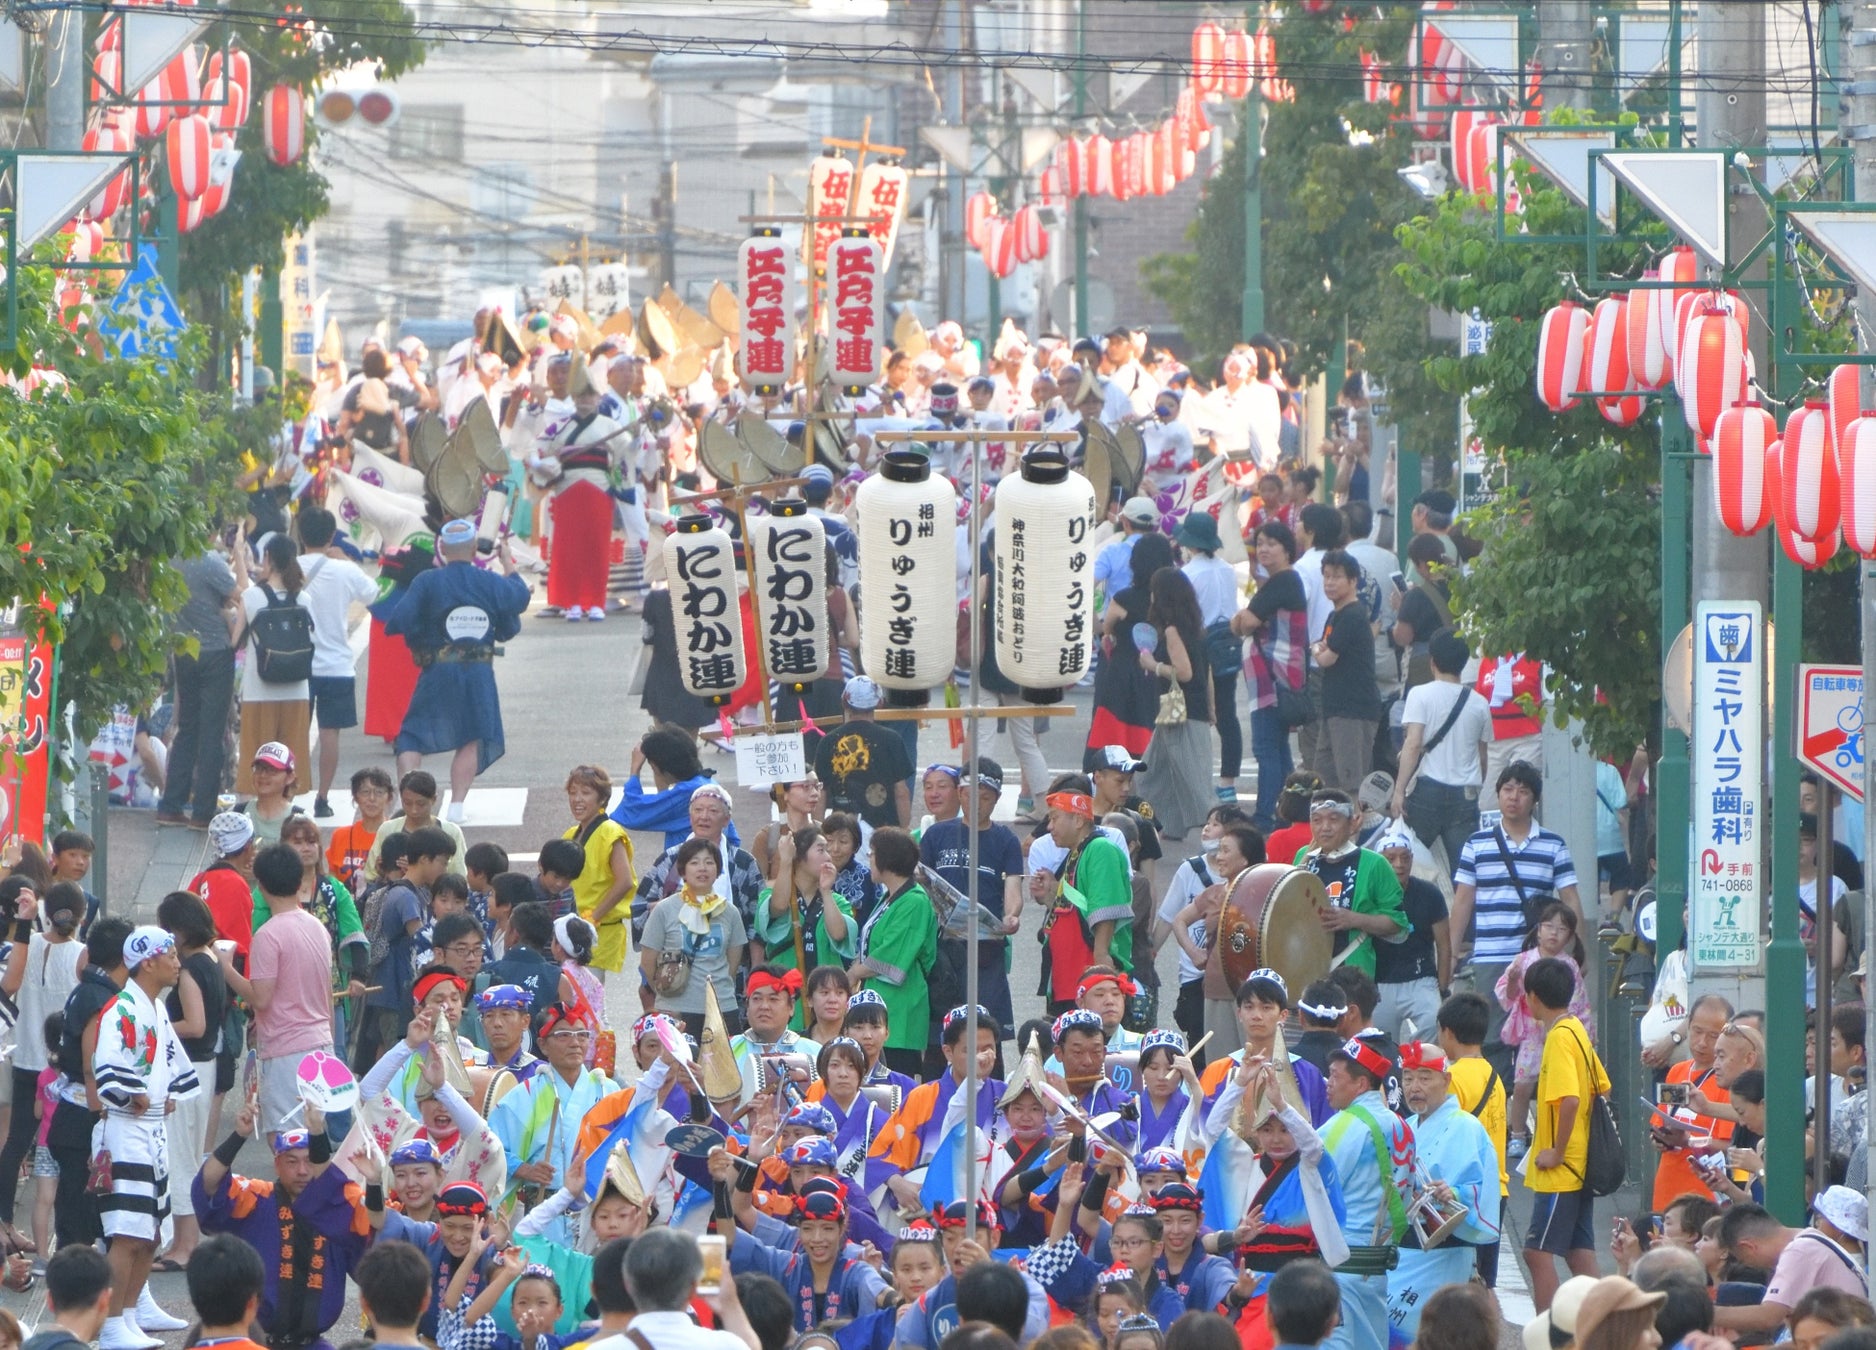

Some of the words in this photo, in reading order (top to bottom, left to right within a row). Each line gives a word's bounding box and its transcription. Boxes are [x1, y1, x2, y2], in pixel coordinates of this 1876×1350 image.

[746, 246, 786, 374] 江戸っ子連
[835, 245, 875, 373] 江戸っ子連
[918, 503, 935, 538] 相州
[676, 544, 737, 691] にわか連
[768, 526, 818, 675] にわか連
[885, 517, 917, 679] りゅうぎ連
[1012, 518, 1025, 663] 神奈川大和阿波おどり
[1059, 516, 1086, 676] りゅうぎ連
[1719, 624, 1740, 646] 歯
[743, 740, 799, 753] 一般の方も
[1712, 669, 1743, 845] ミヤハラ歯科
[1701, 879, 1753, 891] 741-0868
[1727, 862, 1753, 876] 手前
[1698, 932, 1755, 943] シャンテ大通り
[278, 1206, 294, 1280] みずき連
[1388, 1286, 1419, 1327] 相州
